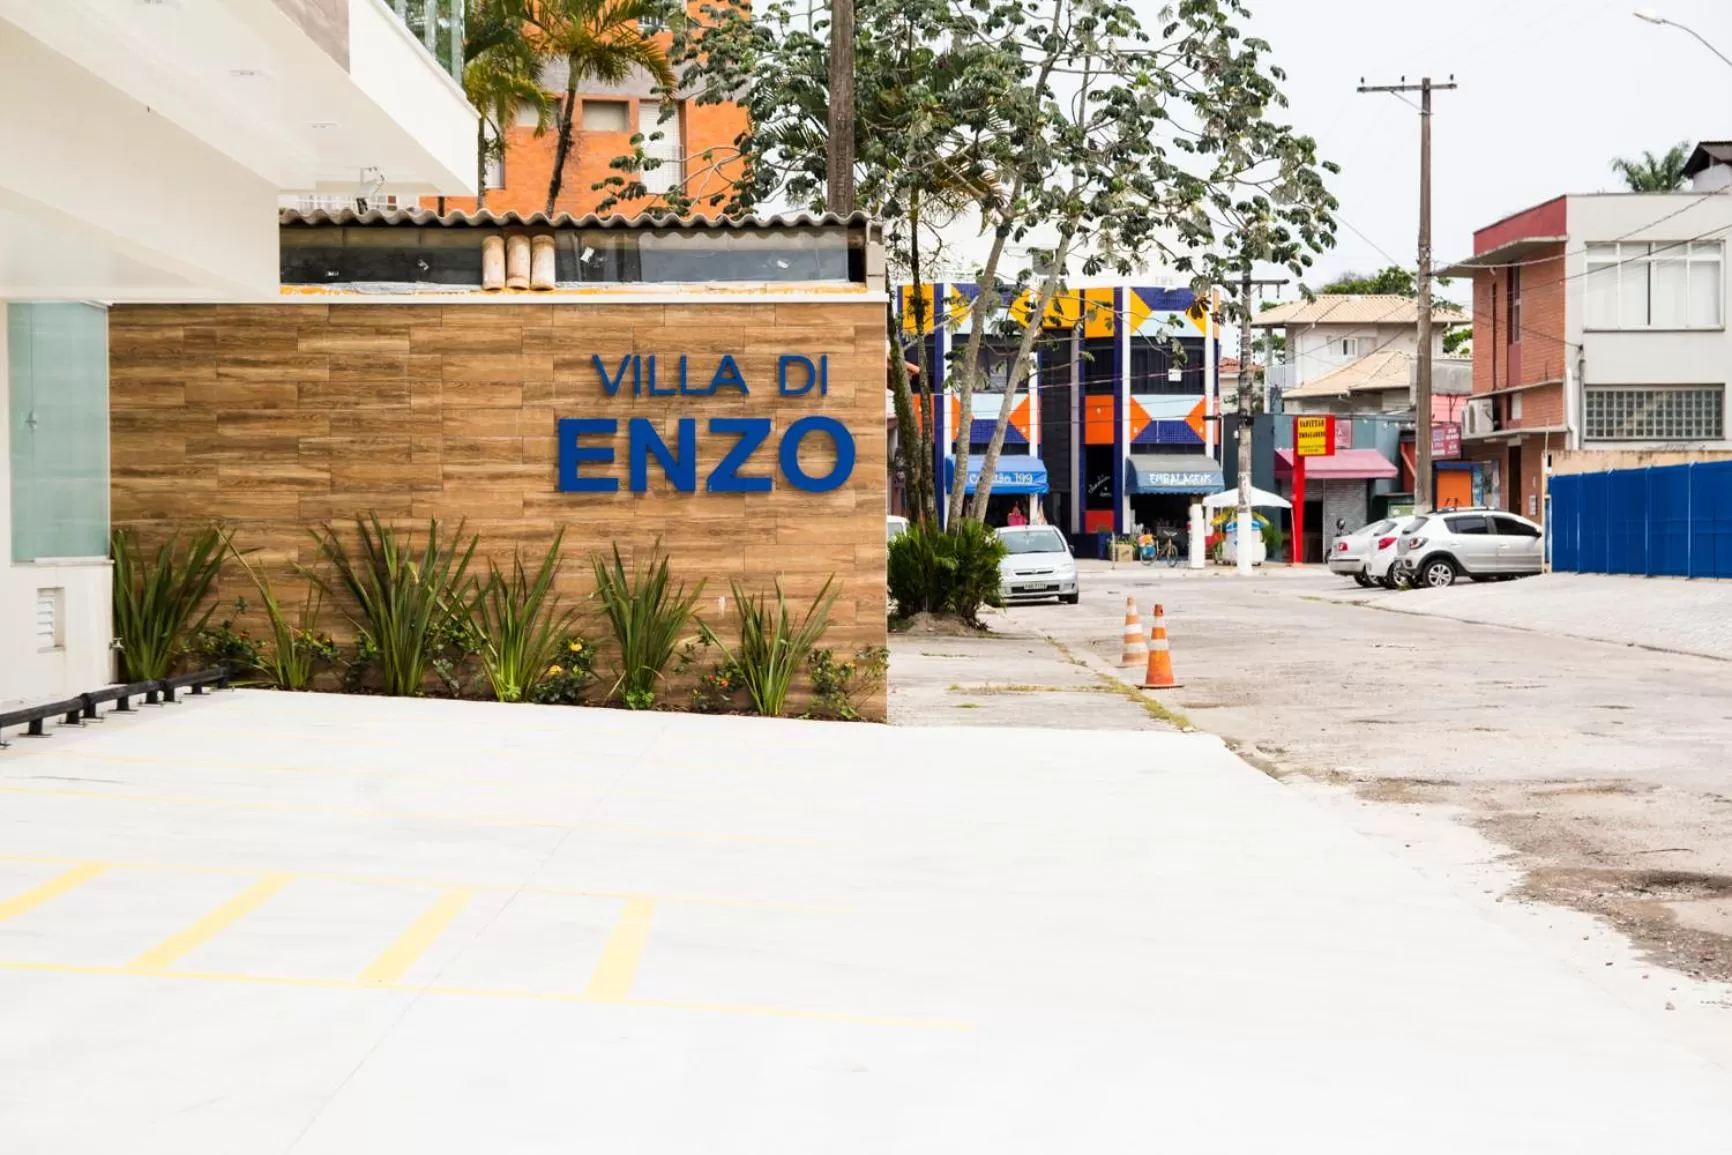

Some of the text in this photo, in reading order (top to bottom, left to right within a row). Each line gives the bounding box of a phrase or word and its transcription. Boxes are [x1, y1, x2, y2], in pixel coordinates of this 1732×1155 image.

[591, 353, 828, 396] VILLA DI
[558, 416, 856, 493] ENZO
